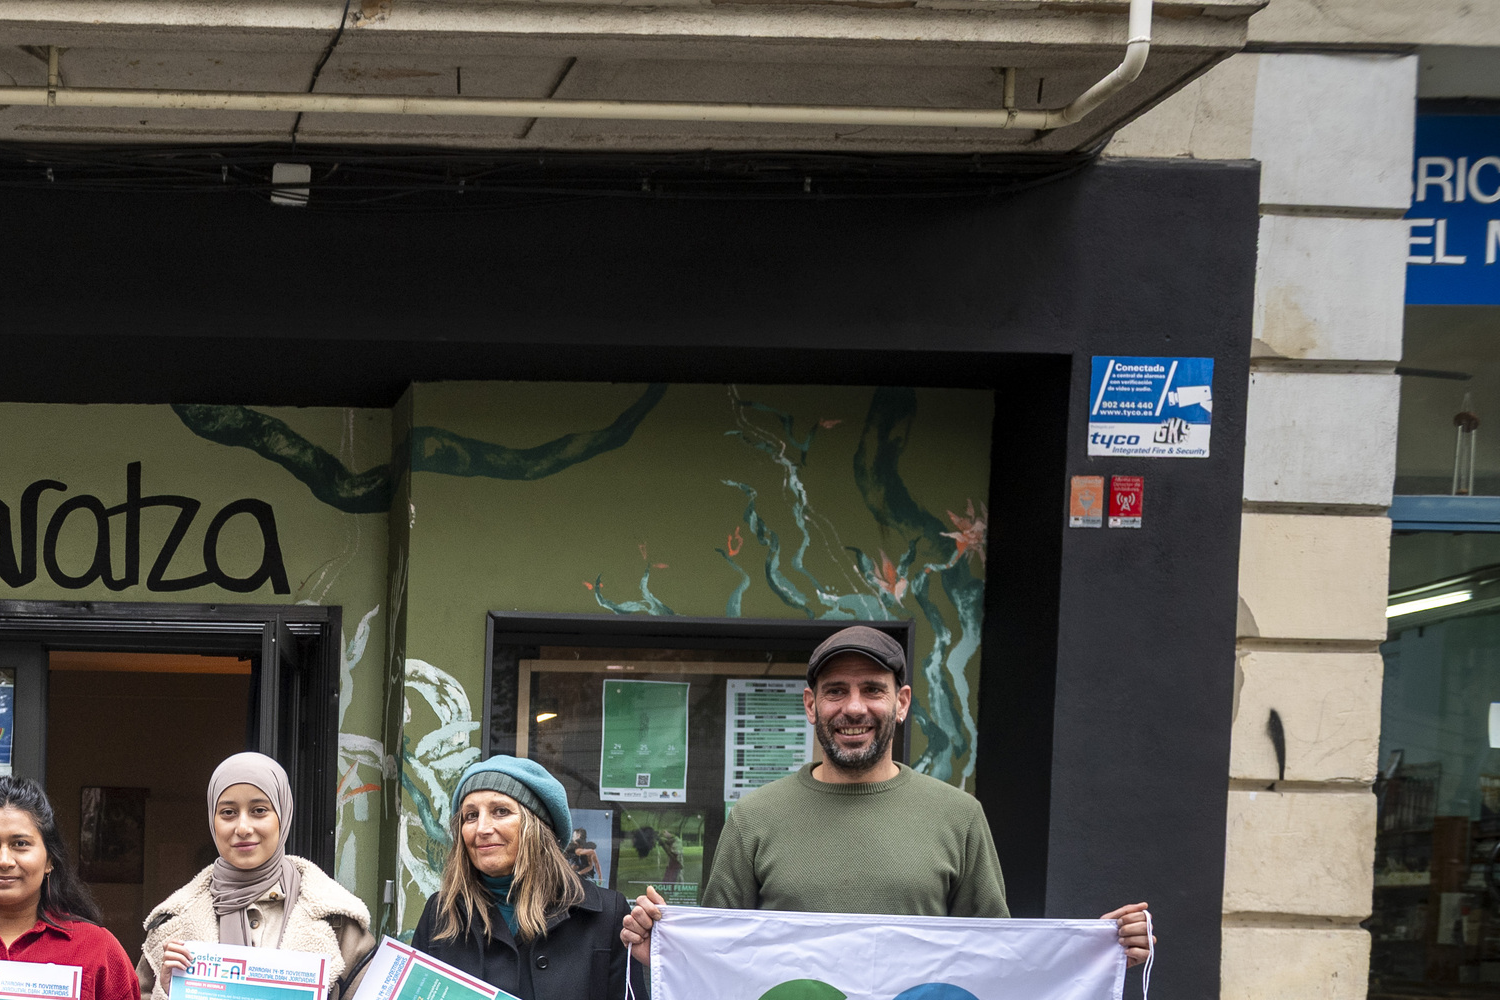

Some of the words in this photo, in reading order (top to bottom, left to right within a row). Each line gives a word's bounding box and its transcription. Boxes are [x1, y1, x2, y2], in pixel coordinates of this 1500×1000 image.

[1115, 363, 1165, 373] Conectada
[1102, 401, 1118, 409] 902
[1119, 401, 1136, 409] 444
[1100, 409, 1153, 417] www.tyco.es
[1090, 432, 1140, 448] tyco
[1112, 446, 1151, 455] Integrated
[1152, 446, 1166, 454] Fire
[1176, 447, 1207, 456] Security
